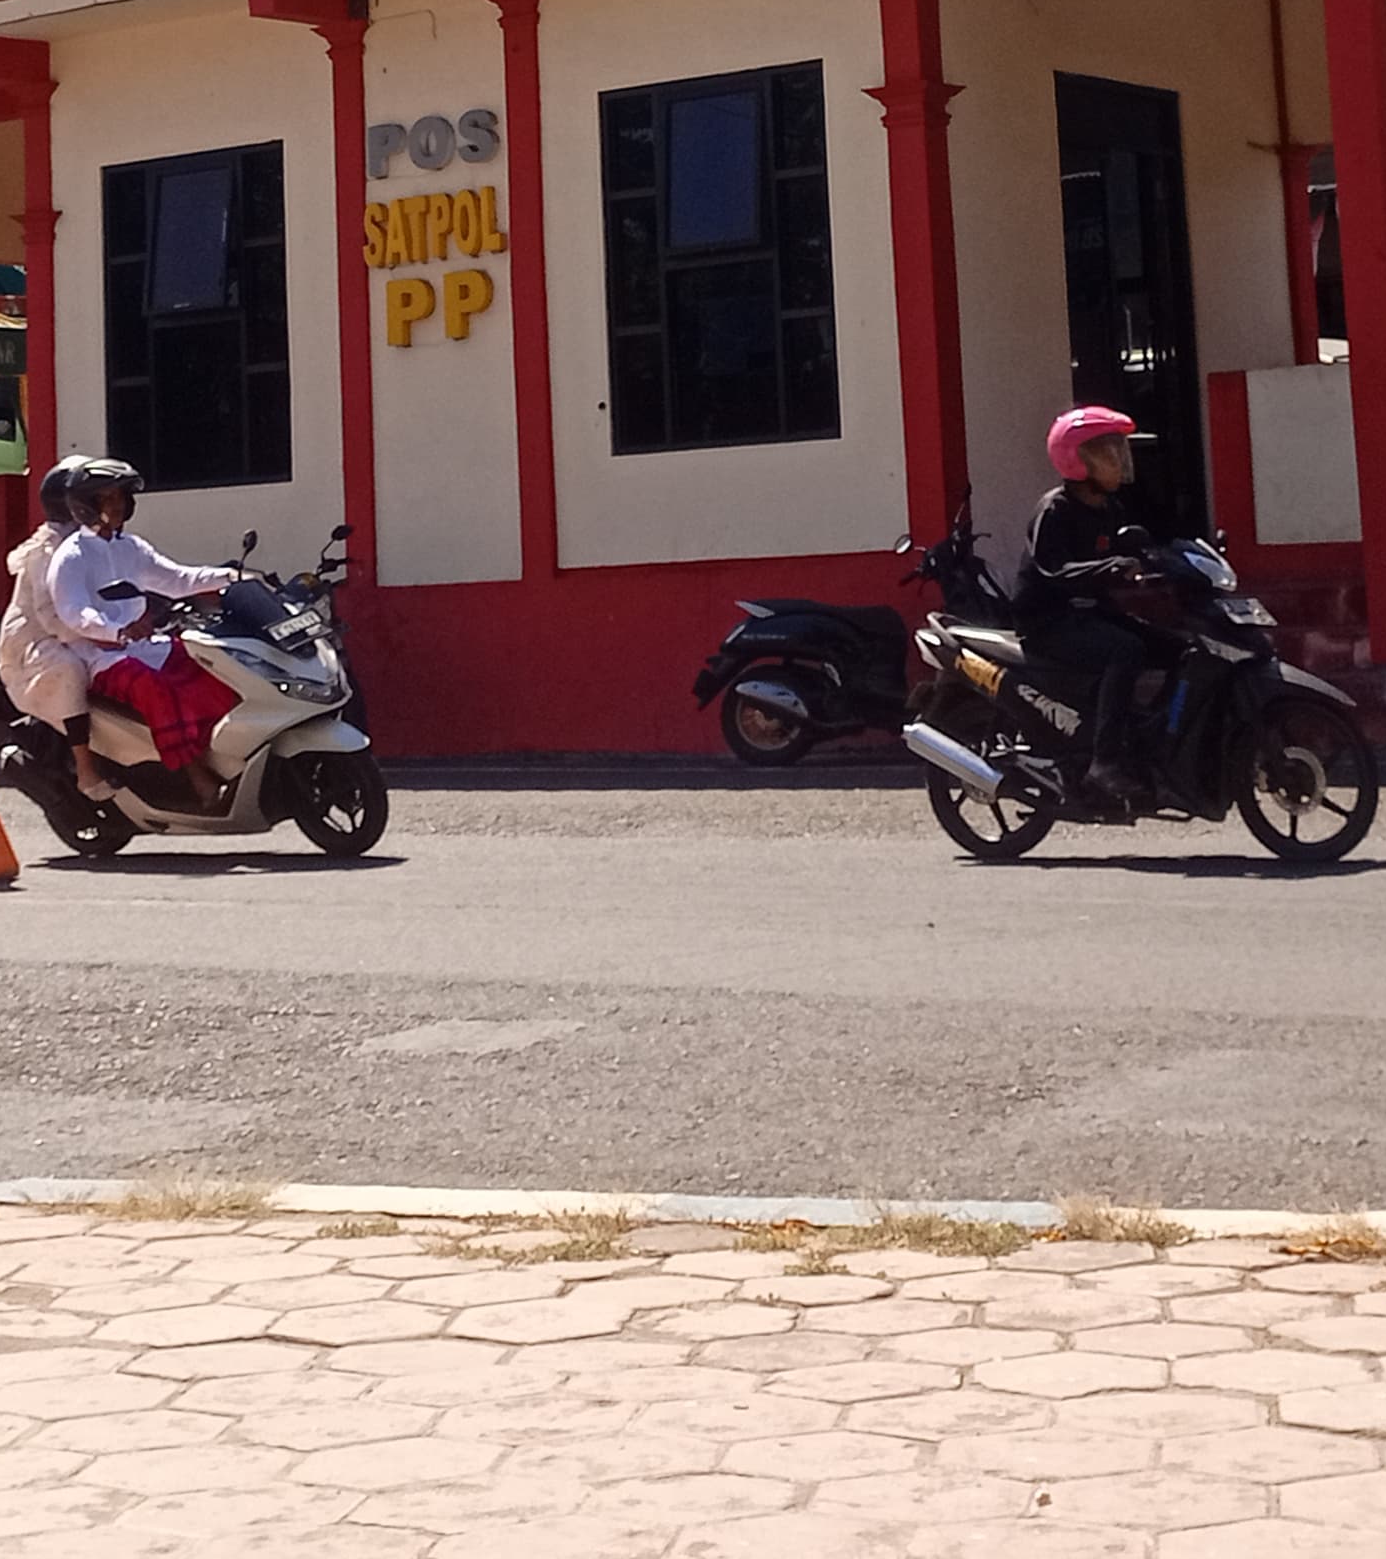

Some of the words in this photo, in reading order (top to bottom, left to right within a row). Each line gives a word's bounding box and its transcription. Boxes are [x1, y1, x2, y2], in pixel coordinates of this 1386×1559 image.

[367, 108, 501, 179] POS
[363, 186, 507, 270] SATPOL
[386, 268, 495, 348] PP
